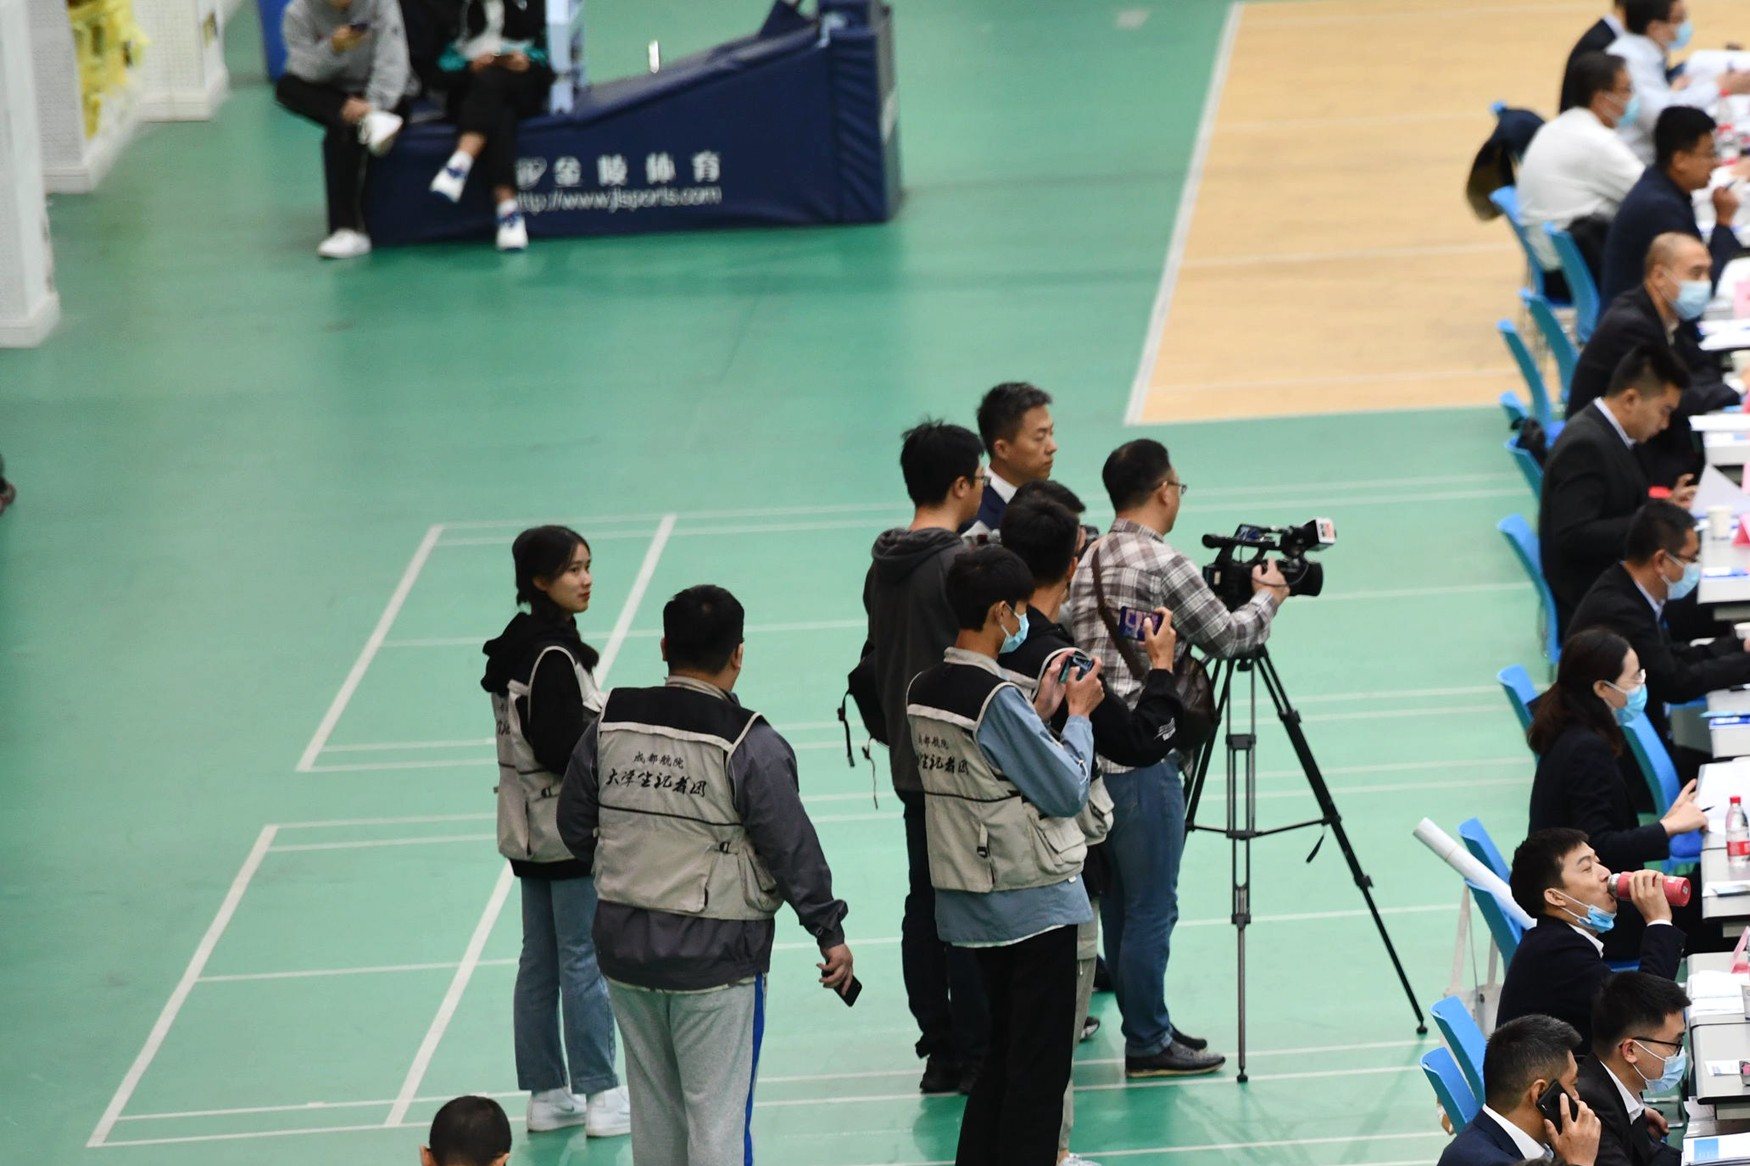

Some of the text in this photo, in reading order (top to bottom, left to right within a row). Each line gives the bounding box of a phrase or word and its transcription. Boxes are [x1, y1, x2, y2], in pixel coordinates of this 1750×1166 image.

[553, 150, 720, 188] 金陵体育
[633, 749, 684, 769] 成都航院
[606, 768, 707, 797] 大学生记者团
